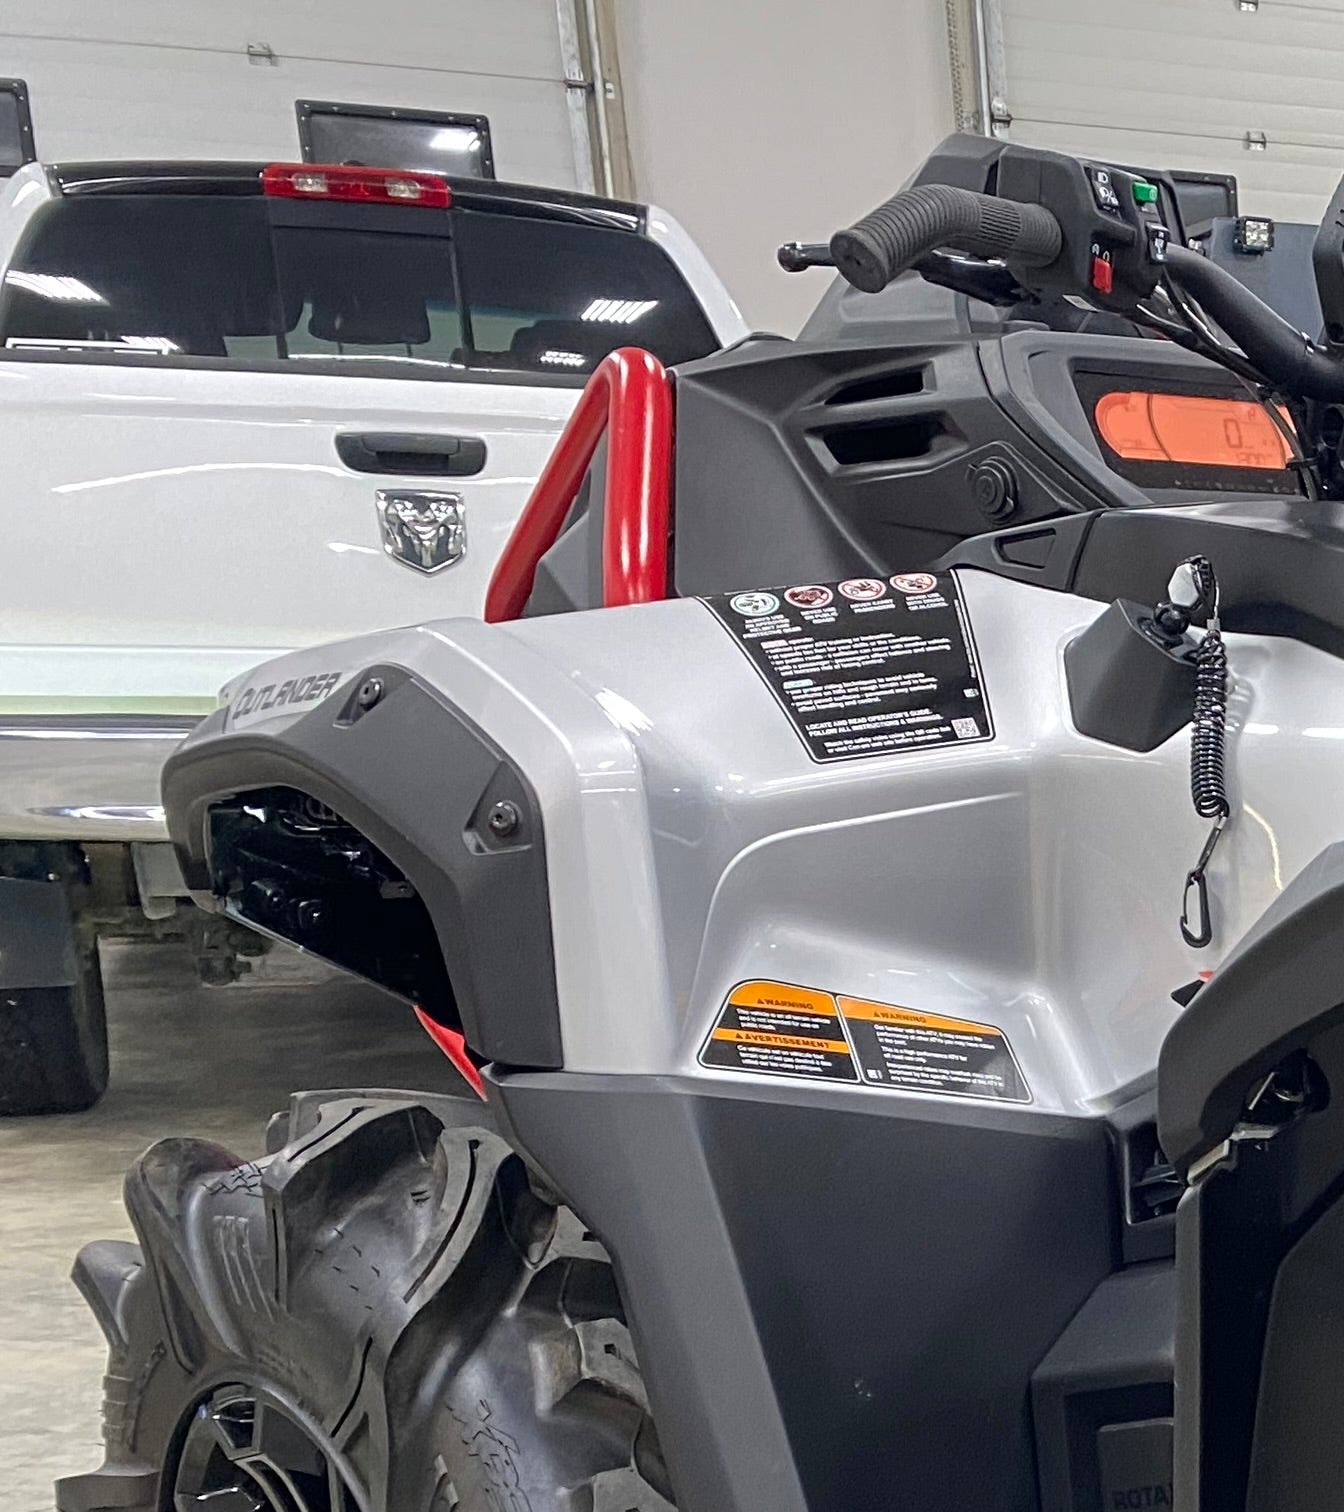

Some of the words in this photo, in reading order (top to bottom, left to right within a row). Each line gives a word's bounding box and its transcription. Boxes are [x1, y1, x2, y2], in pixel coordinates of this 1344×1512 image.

[231, 671, 343, 720] OUTLANDER
[765, 998, 814, 1010] WARNING
[880, 1012, 927, 1023] WARNING
[745, 1034, 830, 1049] AVERTISSEMENT
[1111, 1484, 1173, 1510] ROTA
